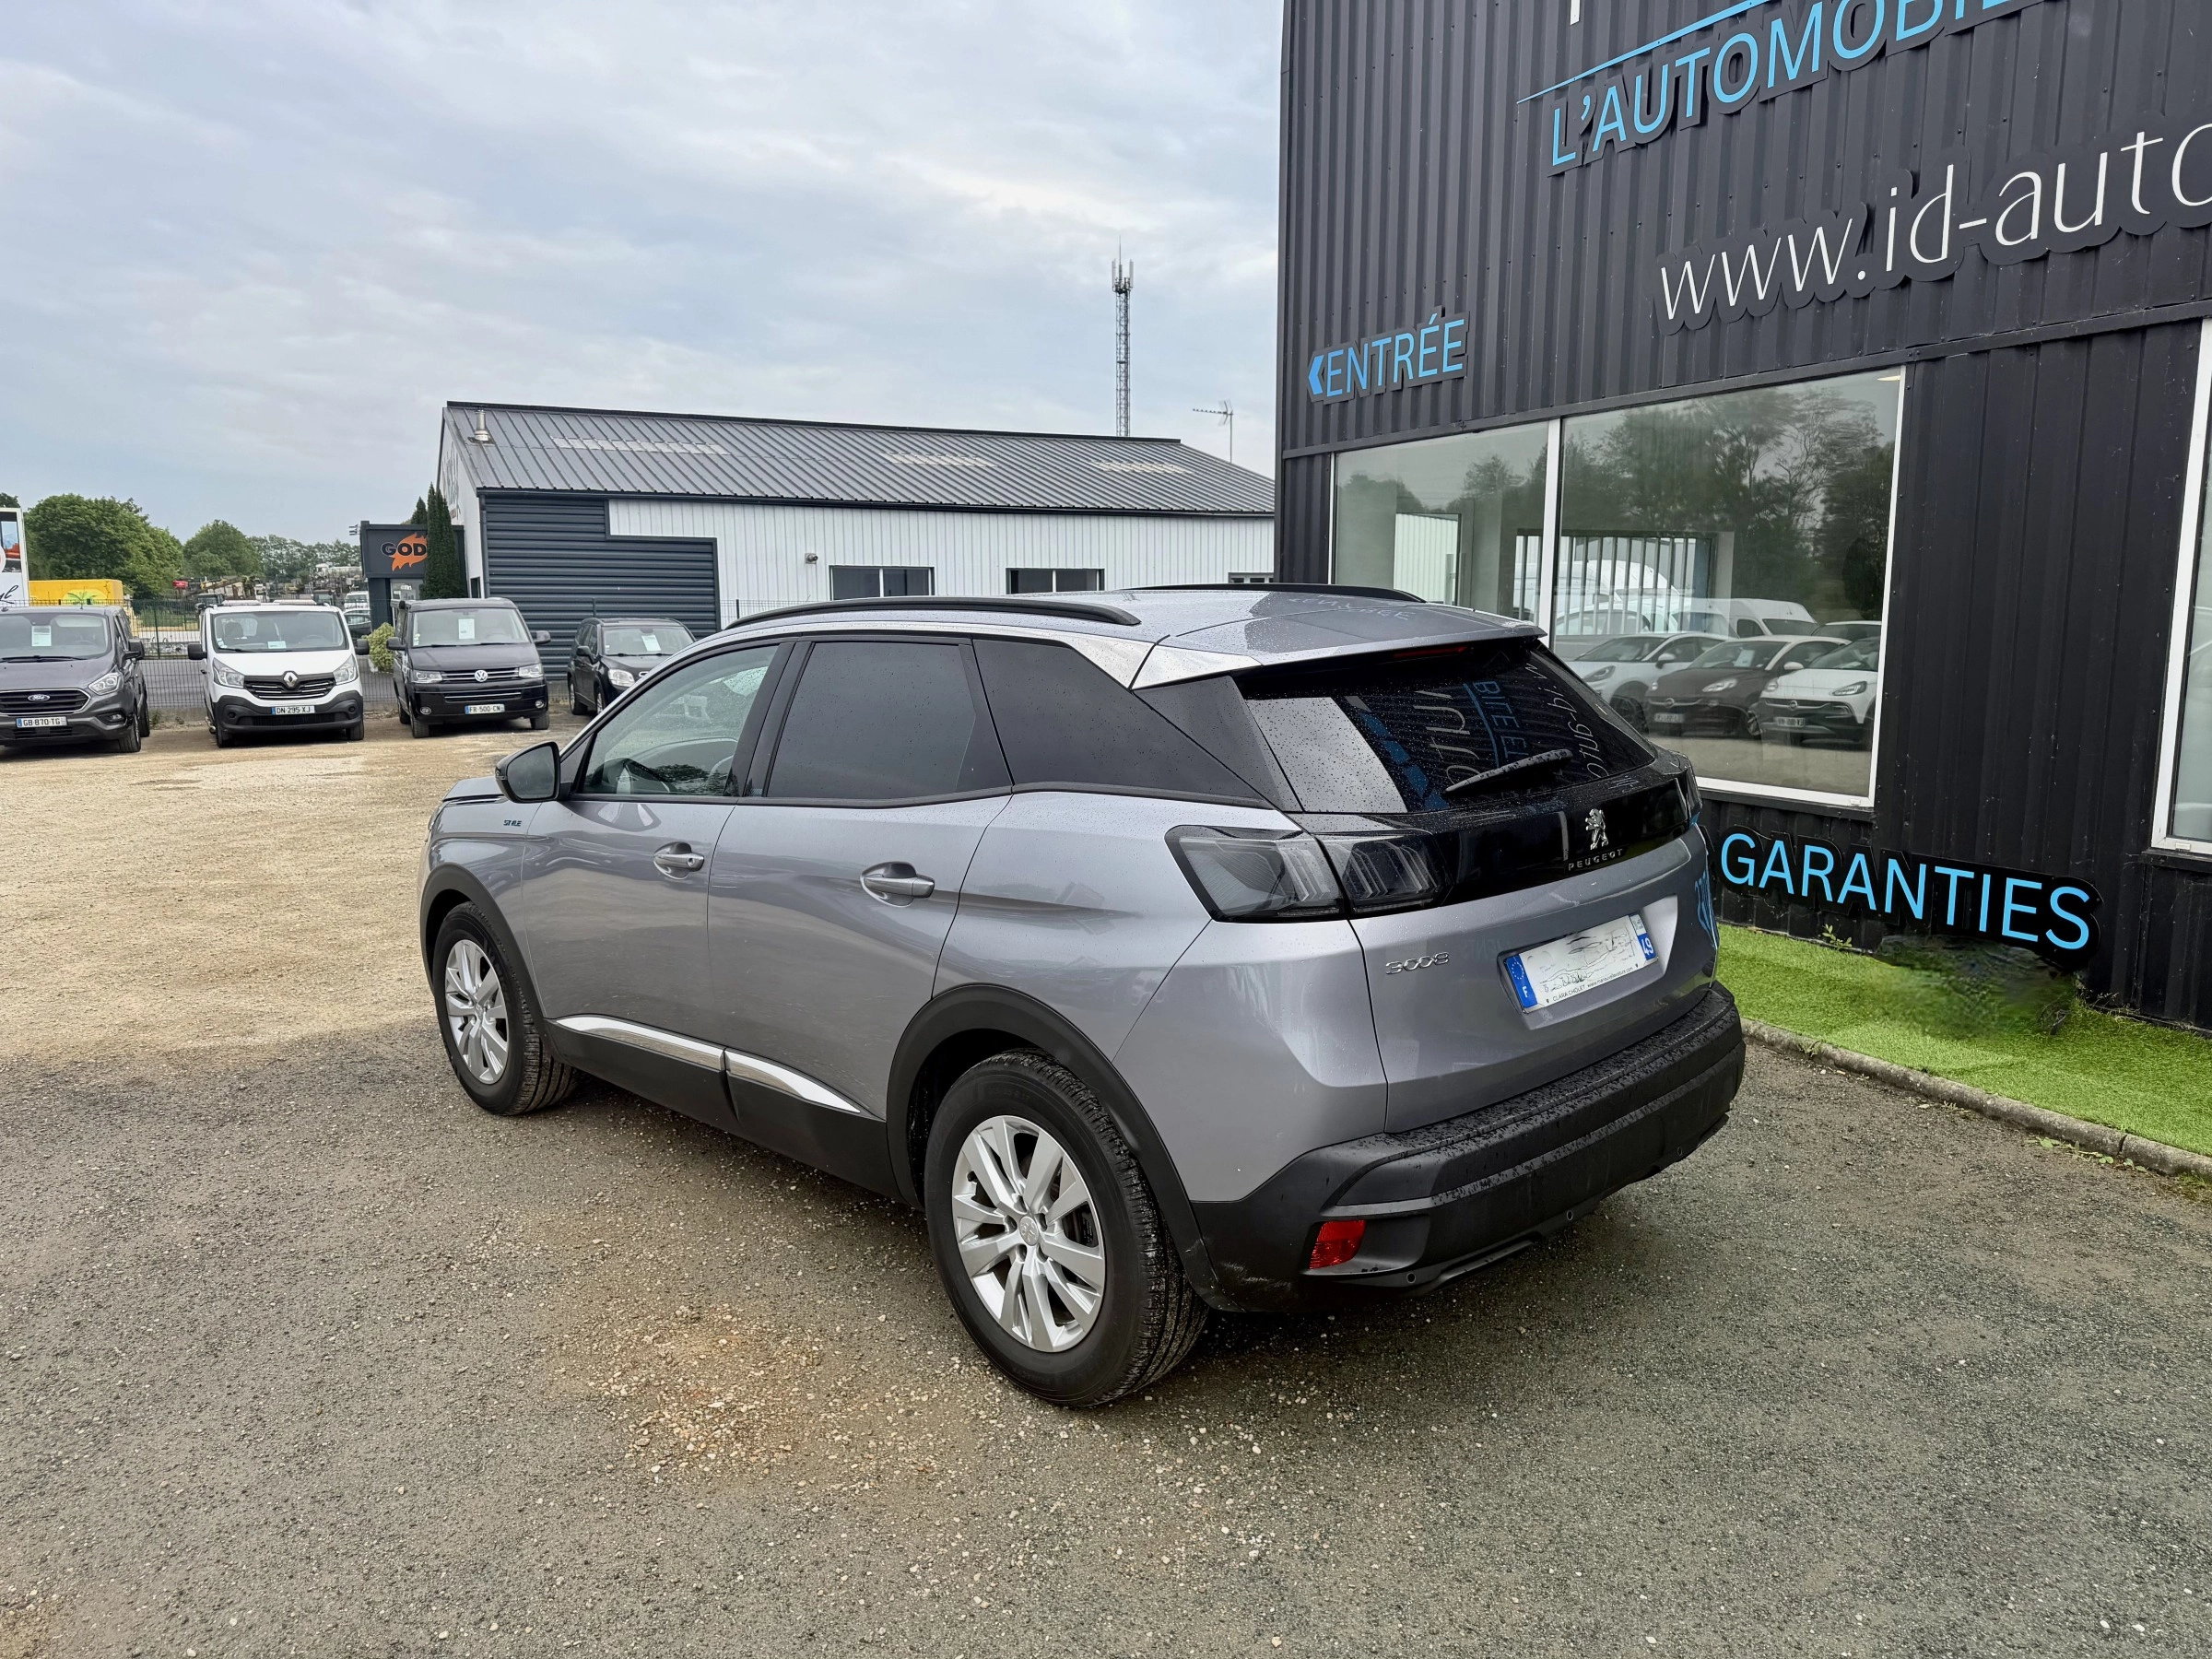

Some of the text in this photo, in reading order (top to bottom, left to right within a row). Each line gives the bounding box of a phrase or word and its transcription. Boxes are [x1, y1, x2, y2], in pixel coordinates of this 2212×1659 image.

[1327, 313, 1465, 396] ENTRÉE
[1568, 849, 1623, 871] PEUGEOT
[1721, 833, 2091, 950] GARANTIES
[1641, 936, 1654, 956] 49
[1385, 951, 1450, 975] 3008
[1552, 990, 1569, 1002] CLARA
[1569, 984, 1585, 996] CHOLET
